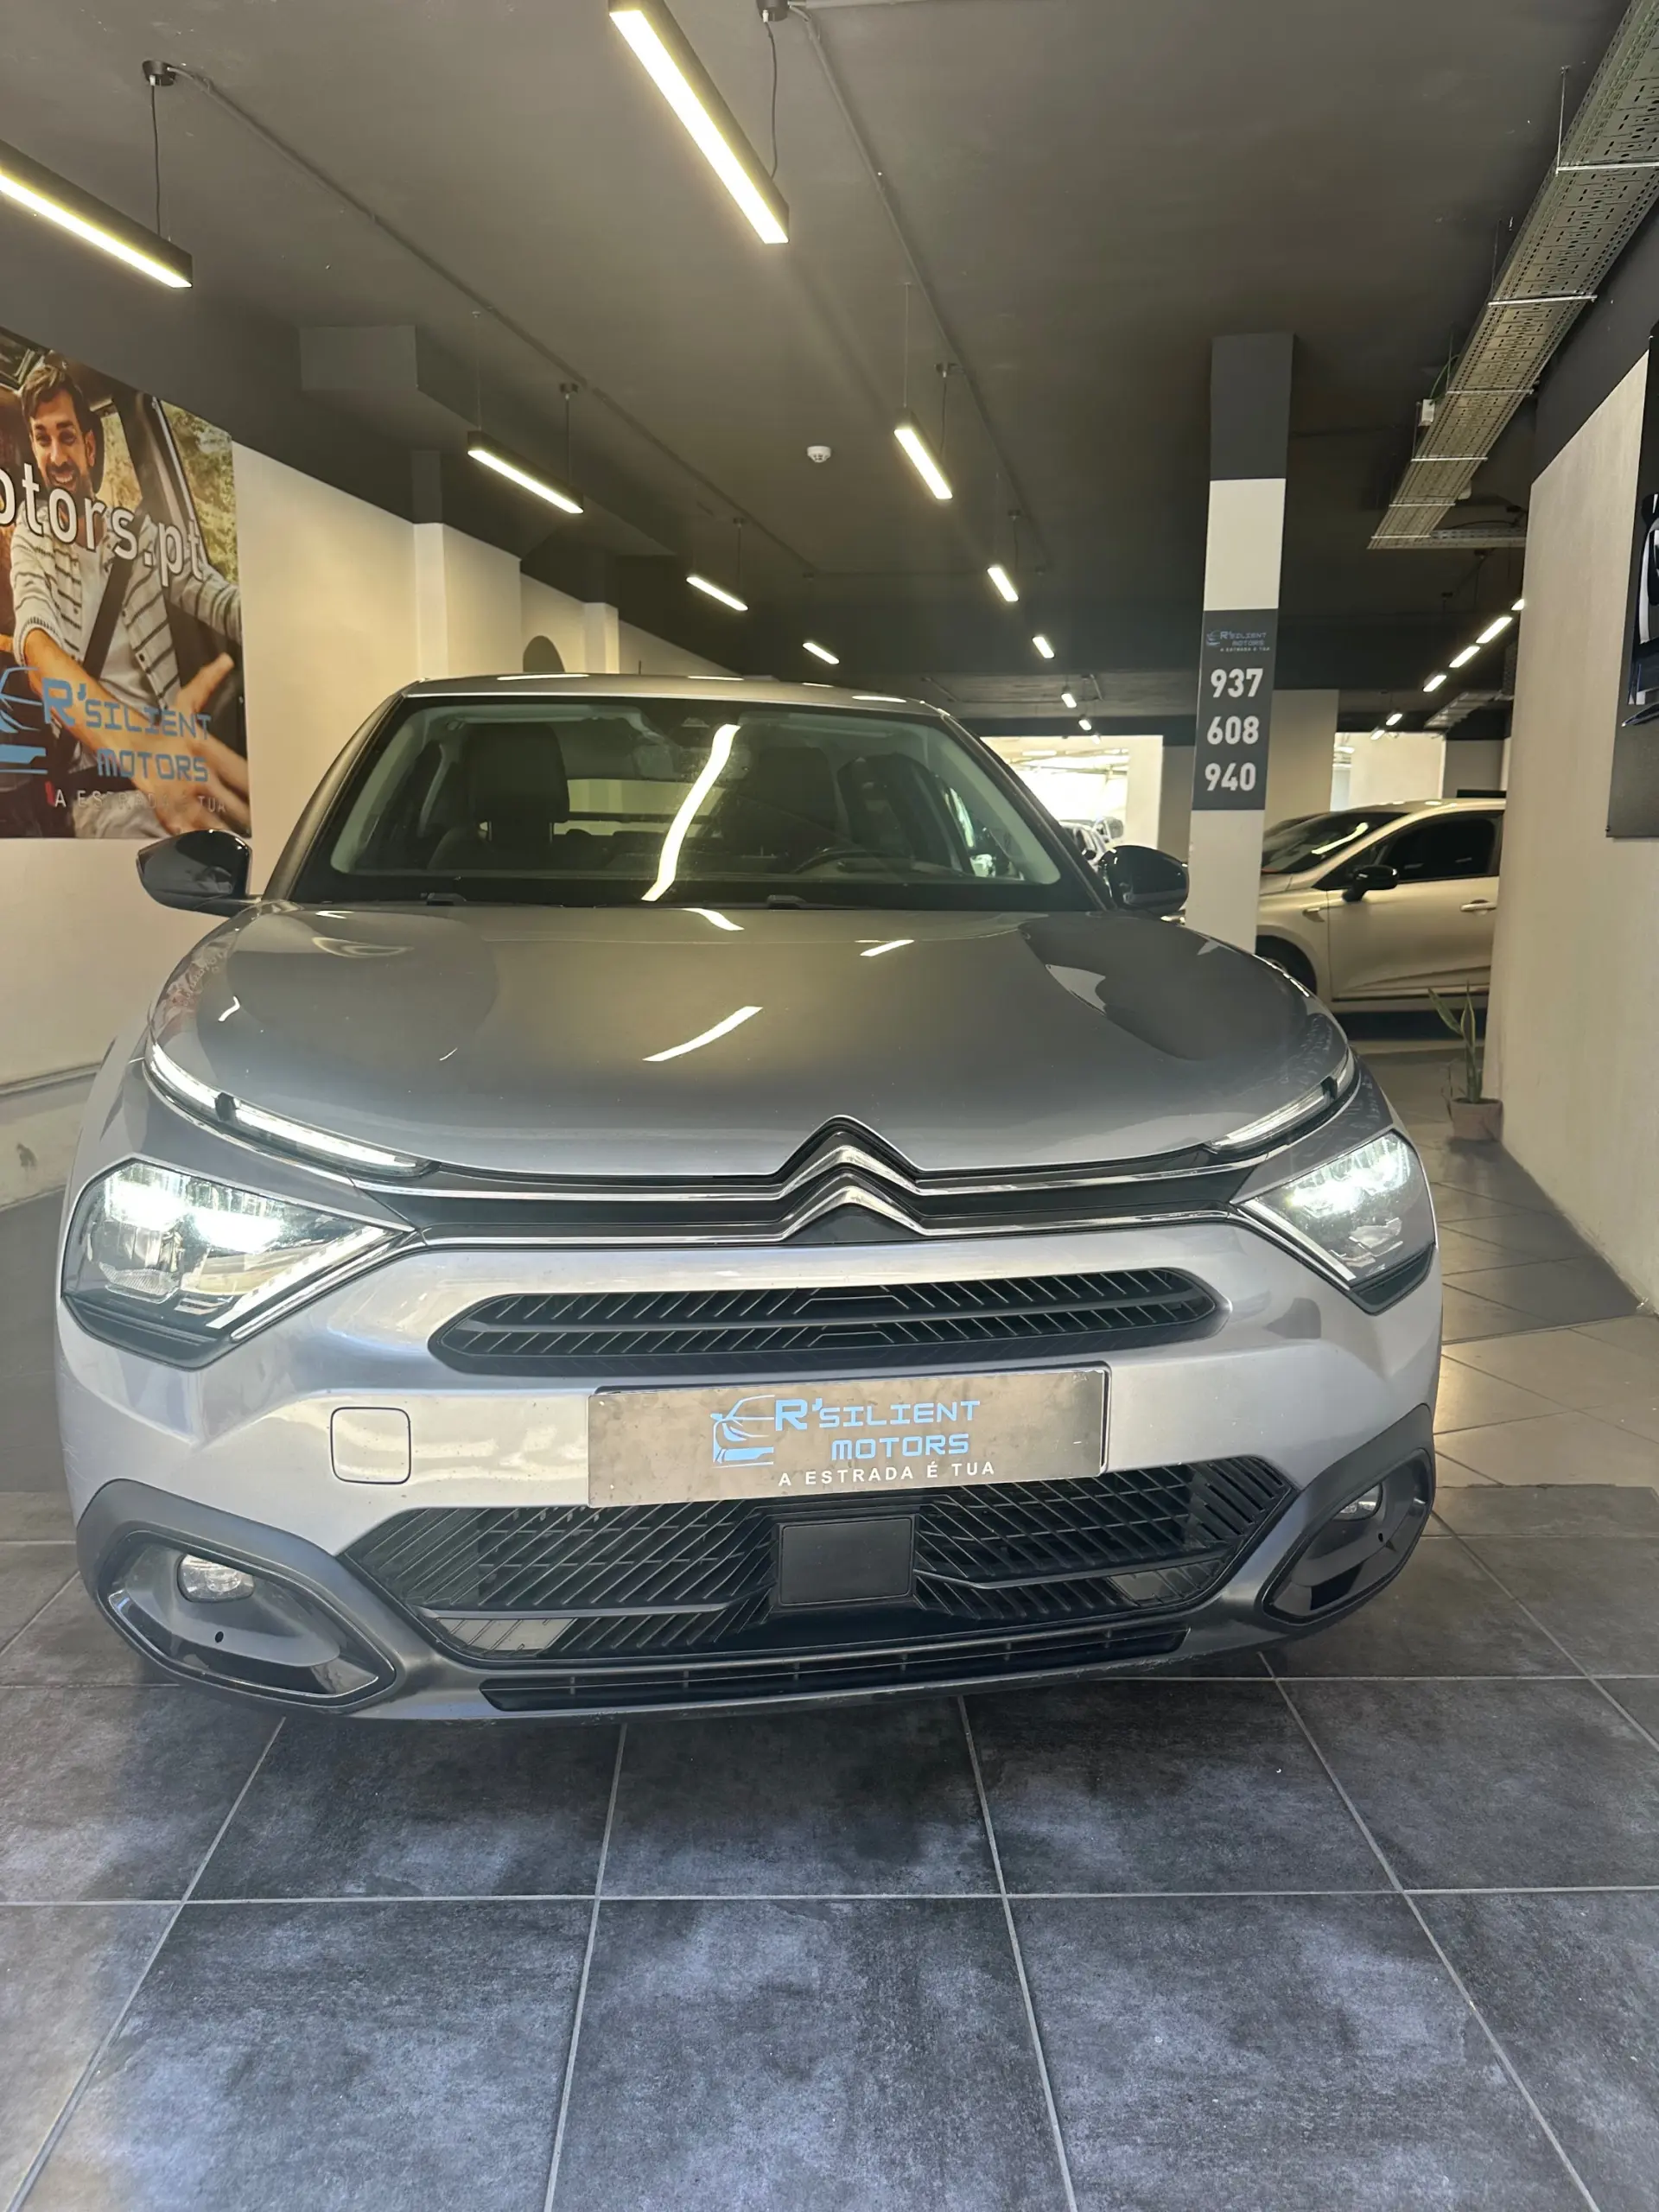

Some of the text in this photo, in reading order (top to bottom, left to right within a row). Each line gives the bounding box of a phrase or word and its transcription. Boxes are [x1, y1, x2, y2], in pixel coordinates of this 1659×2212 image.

[1211, 668, 1263, 698] 937
[43, 677, 211, 740] R'SILIENT
[1206, 715, 1260, 745] 608
[97, 747, 208, 782] MOTORS
[1205, 762, 1256, 791] 940
[54, 789, 67, 808] A
[198, 795, 226, 813] TUA
[775, 1398, 981, 1431] R'SILIENT
[831, 1433, 969, 1460] MOTORS
[779, 1461, 995, 1486] A ESTRADA É TUA
